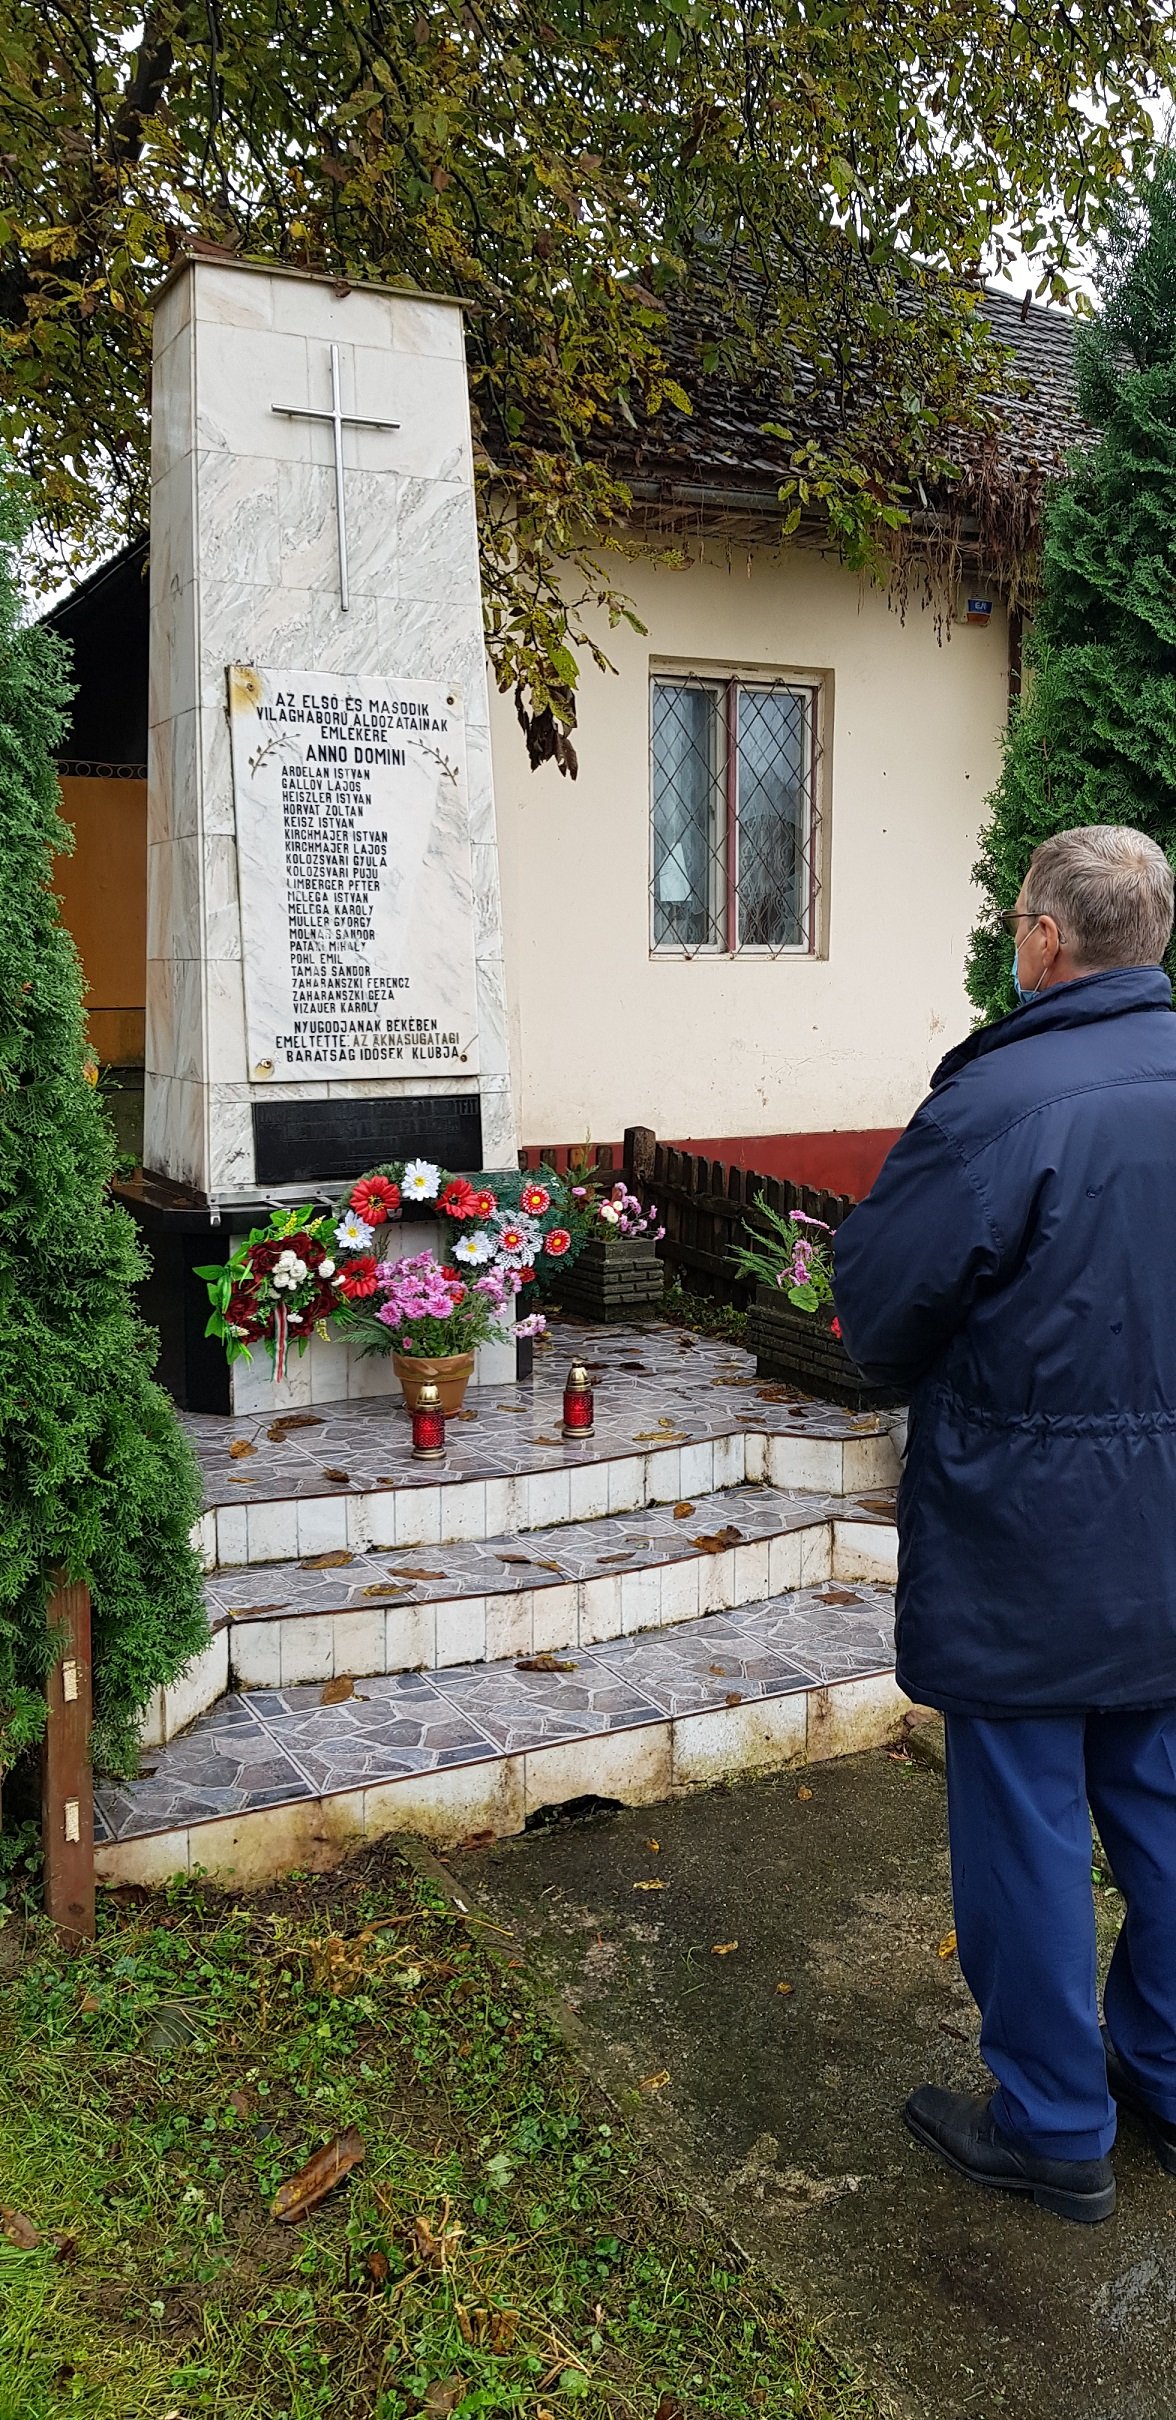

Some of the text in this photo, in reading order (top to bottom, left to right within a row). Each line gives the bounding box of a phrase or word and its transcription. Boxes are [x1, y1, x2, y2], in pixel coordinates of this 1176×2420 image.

[276, 693, 295, 707] AZ
[369, 700, 429, 716] MASODIK
[306, 744, 406, 766] ANNO DOMINI
[282, 766, 370, 780] ARDELAN ISTVAN
[282, 778, 361, 792] GALLOV LAJOS
[282, 791, 371, 805] HEISZLER ISTVAN
[283, 804, 364, 816] HORVAT ZOLTAN
[284, 816, 354, 828] KEISZ ISTVAN
[285, 829, 388, 842] KIRCHMAJER ISTVAN
[285, 842, 387, 855] KIRCHMAJER LAJOS
[286, 854, 387, 867] KOLOZSVARI GYULA
[286, 866, 378, 878] KOLOZSVARI PUJU
[349, 880, 380, 891] PETER
[334, 893, 368, 903] ISTVAN
[288, 904, 373, 915] MELEGA KAROLY
[289, 916, 371, 927] MULLER GYORGY
[291, 954, 343, 964] POHL EMIL
[291, 966, 370, 976] TAMAS SANDOR
[368, 978, 410, 988] FERENCZ
[292, 990, 395, 1001] ZAHARANSZKI GEZA
[293, 1002, 378, 1014] VIZAUER KAROLY
[294, 1020, 381, 1034] NYUGODJANAK
[353, 1034, 369, 1047] AZ
